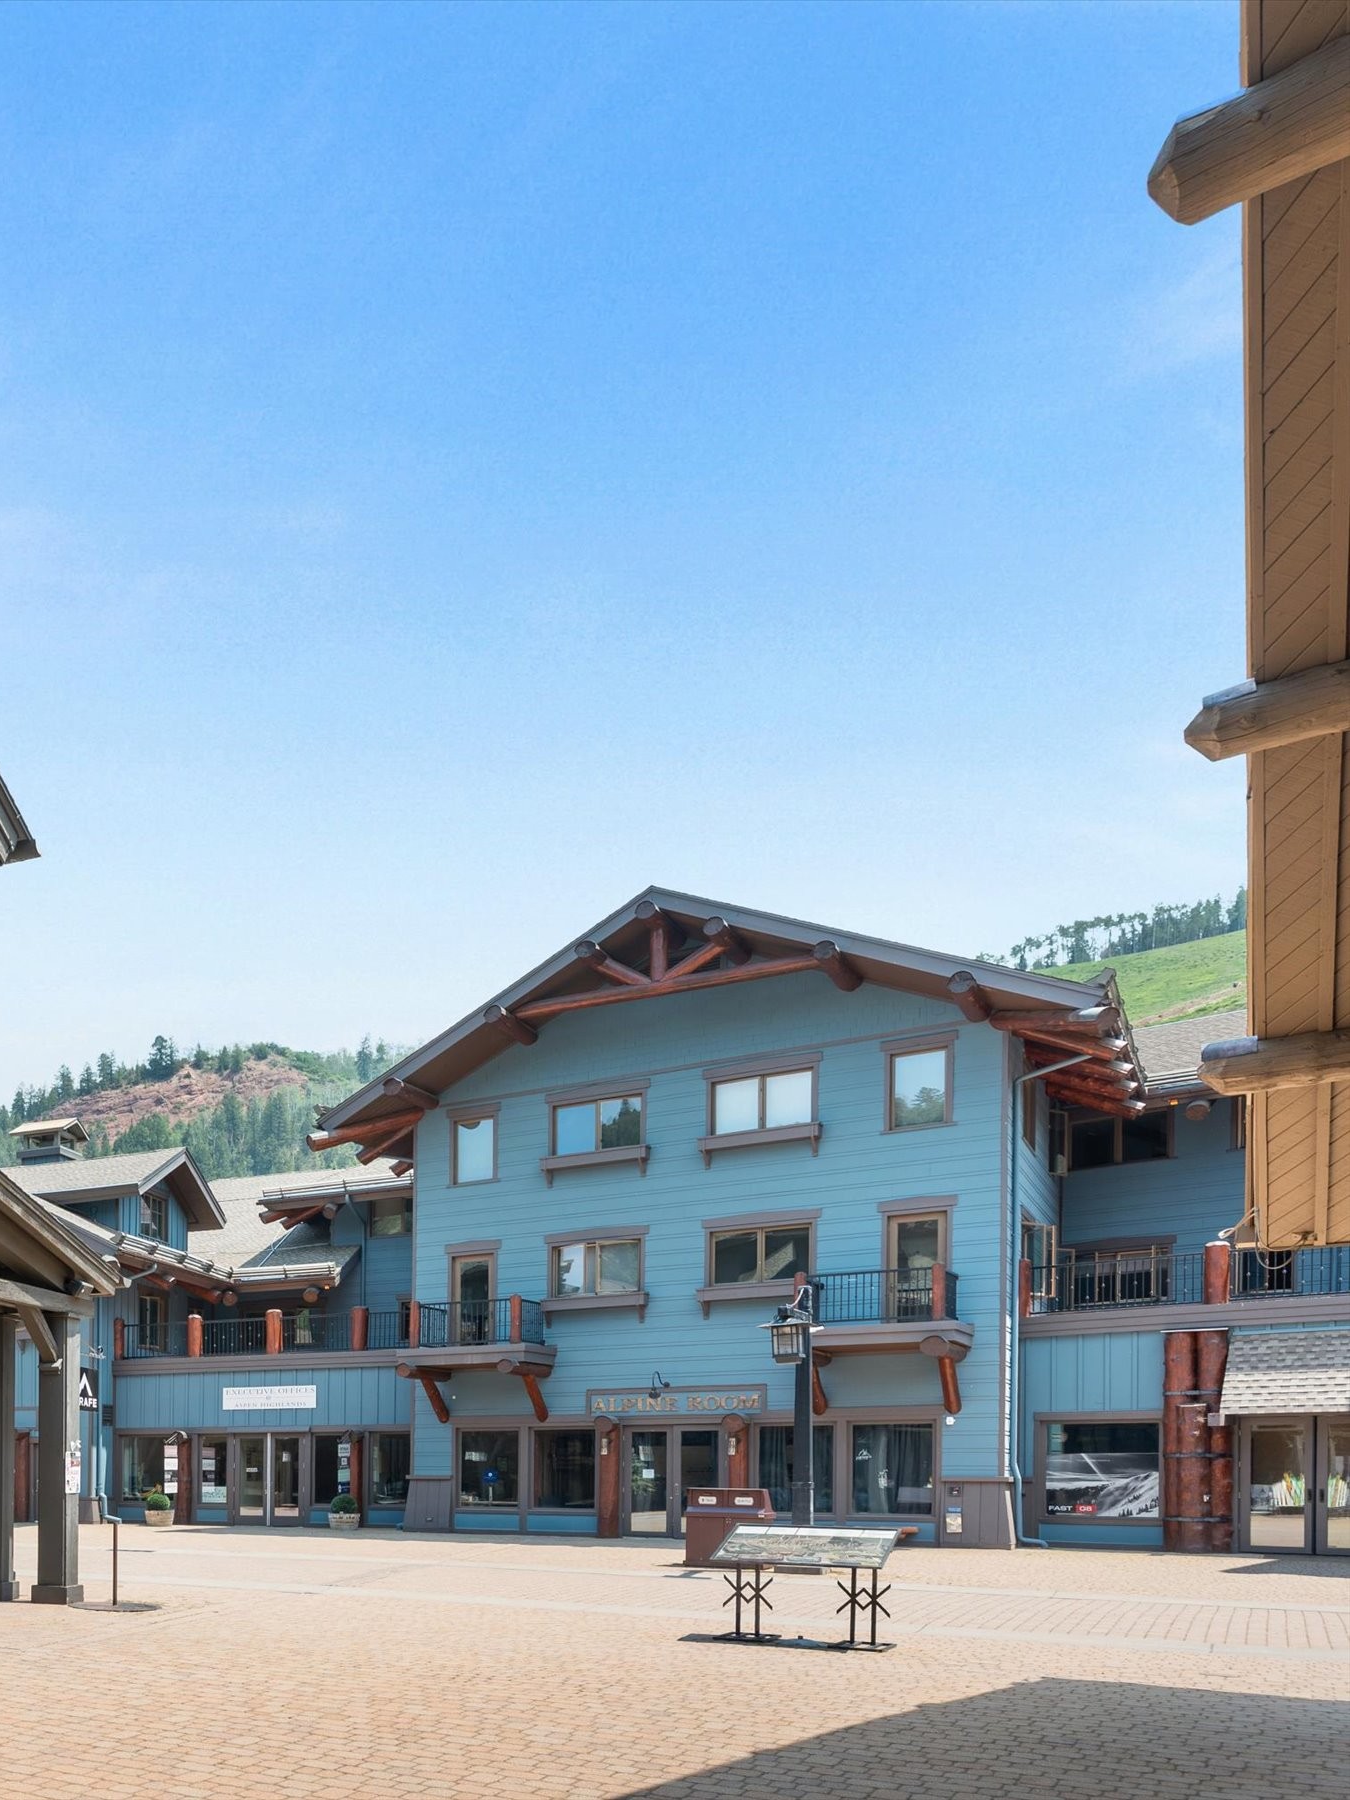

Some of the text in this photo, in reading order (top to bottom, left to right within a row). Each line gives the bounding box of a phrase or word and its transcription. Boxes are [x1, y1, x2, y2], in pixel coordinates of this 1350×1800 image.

[79, 1397, 97, 1408] RAFE
[593, 1394, 761, 1412] ALPINE ROOM
